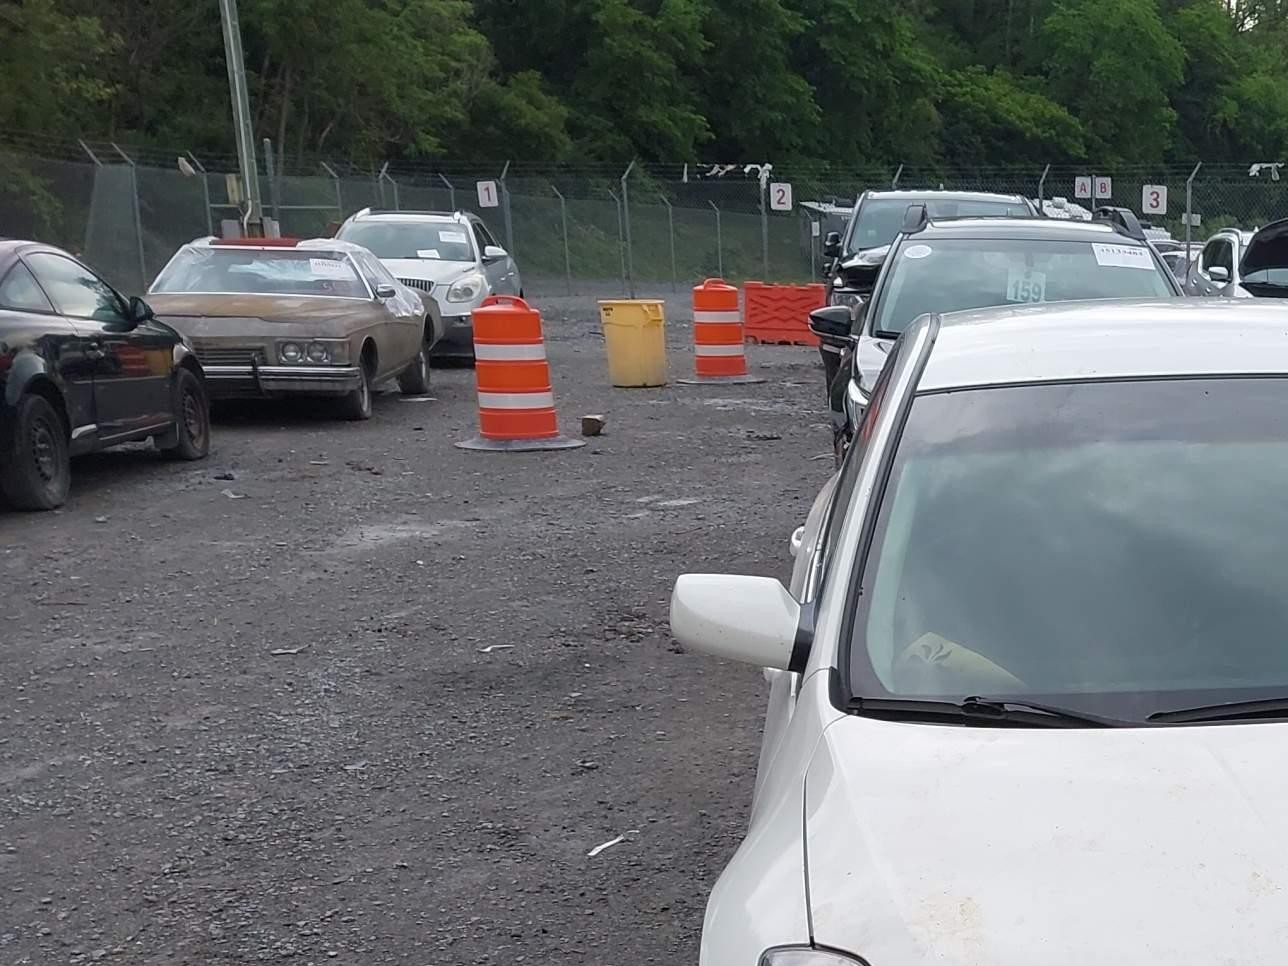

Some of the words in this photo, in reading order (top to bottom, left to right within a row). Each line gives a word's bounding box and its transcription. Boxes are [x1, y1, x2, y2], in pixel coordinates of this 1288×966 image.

[483, 186, 492, 203] 1
[1079, 182, 1088, 194] A
[1099, 182, 1108, 194] B
[776, 188, 787, 206] 2
[1149, 191, 1160, 209] 3
[1011, 279, 1042, 302] 159
